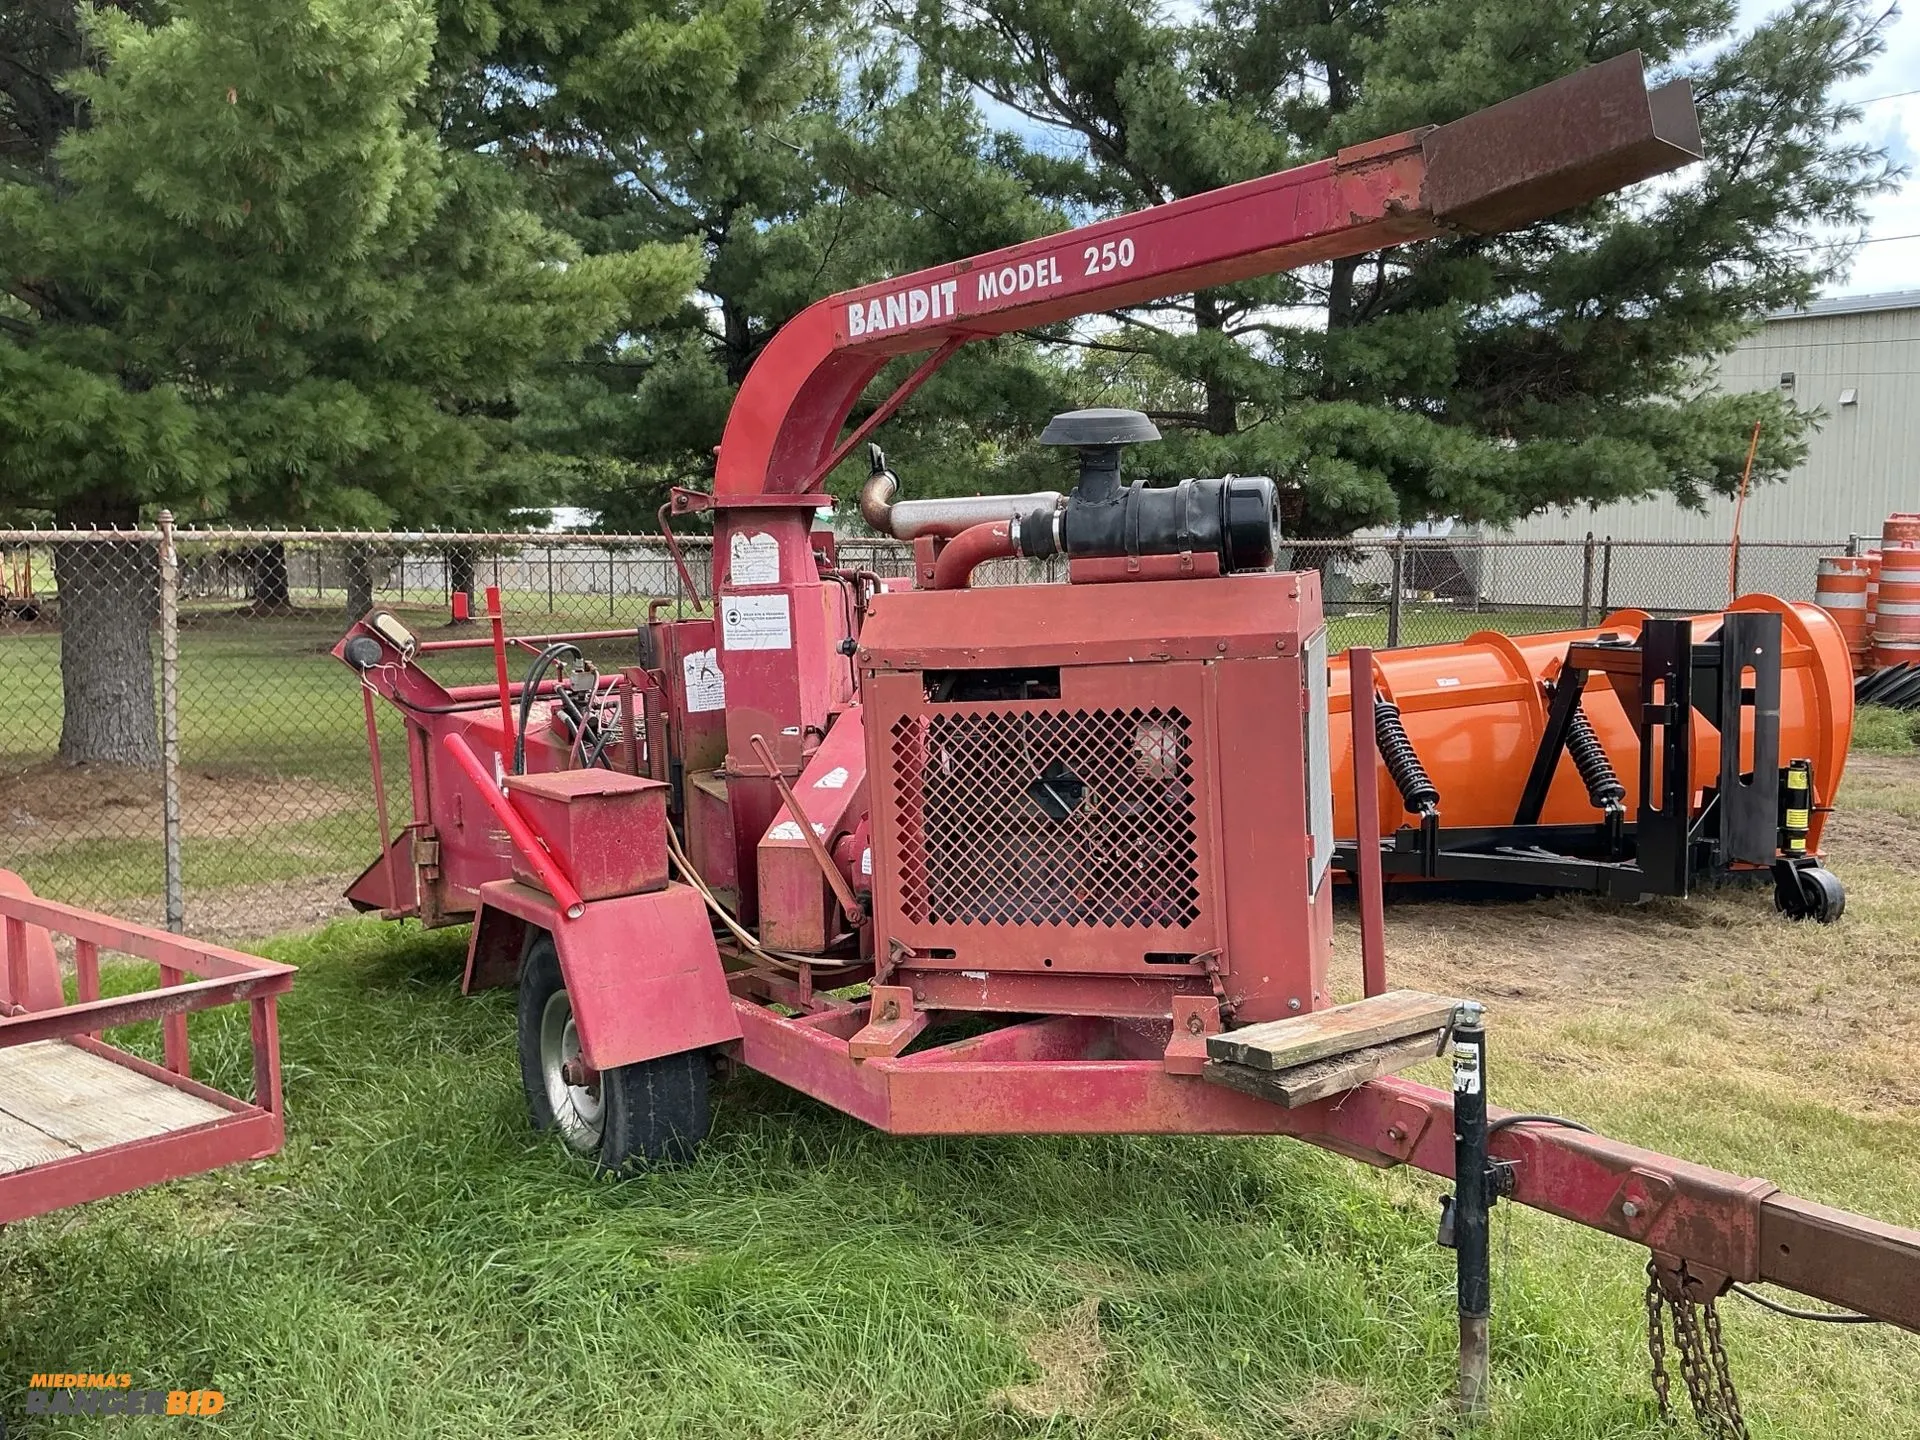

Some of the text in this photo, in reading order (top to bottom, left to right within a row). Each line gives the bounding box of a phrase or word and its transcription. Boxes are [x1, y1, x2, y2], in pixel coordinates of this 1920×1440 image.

[849, 238, 1135, 337] BANDIT MODEL 250
